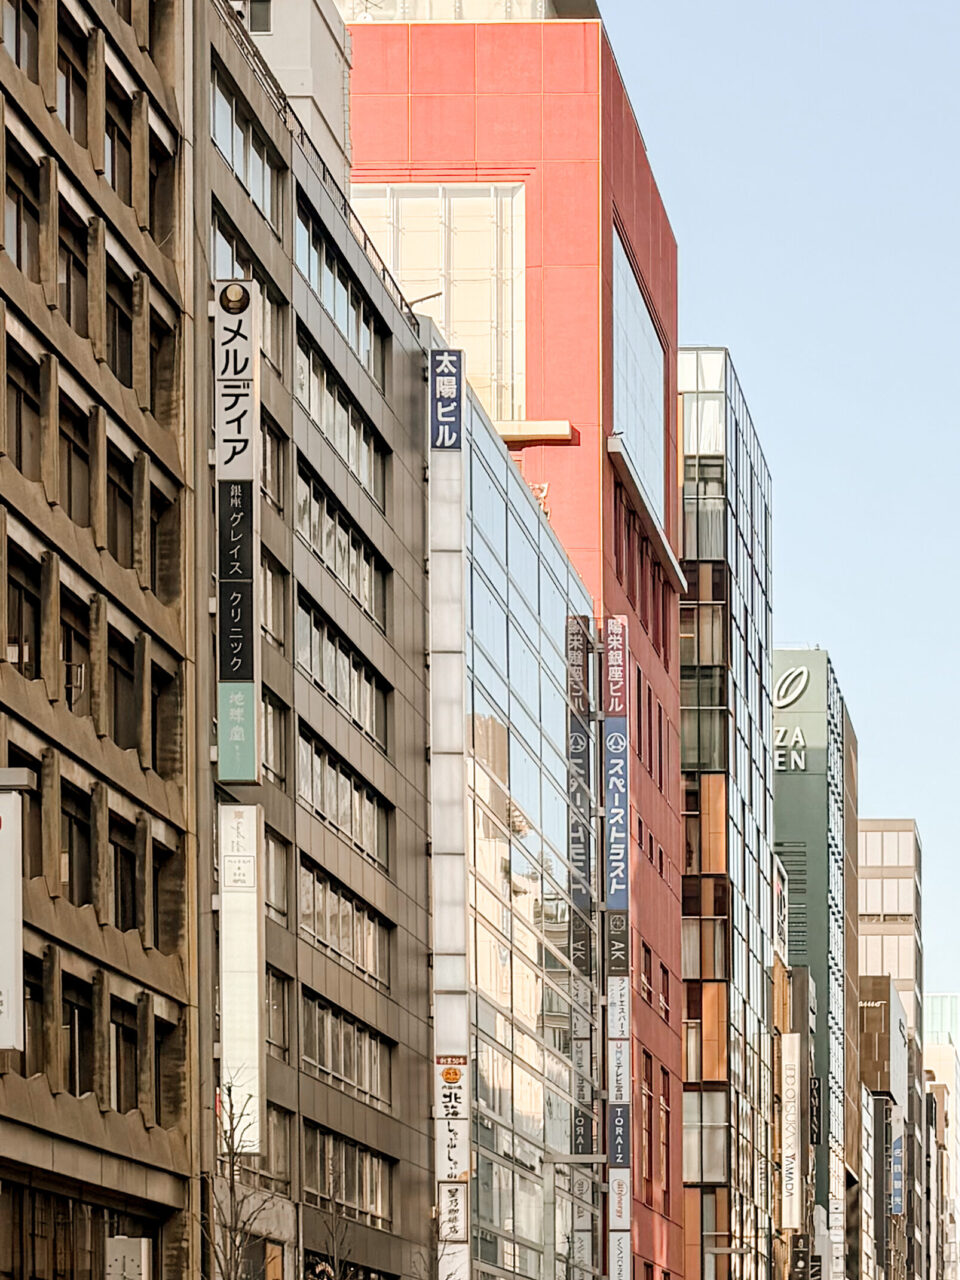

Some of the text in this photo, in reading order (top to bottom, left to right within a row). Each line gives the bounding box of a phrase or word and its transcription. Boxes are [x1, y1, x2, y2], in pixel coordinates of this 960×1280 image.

[221, 319, 250, 465] メルディア
[435, 351, 457, 447] 太陽ビル
[229, 591, 243, 672] クリニック
[607, 619, 624, 712] 陽栄銀座ビル
[608, 758, 626, 895] スペーストラスト
[615, 1108, 624, 1163] TORAIZ
[785, 1153, 796, 1198] YAMADA
